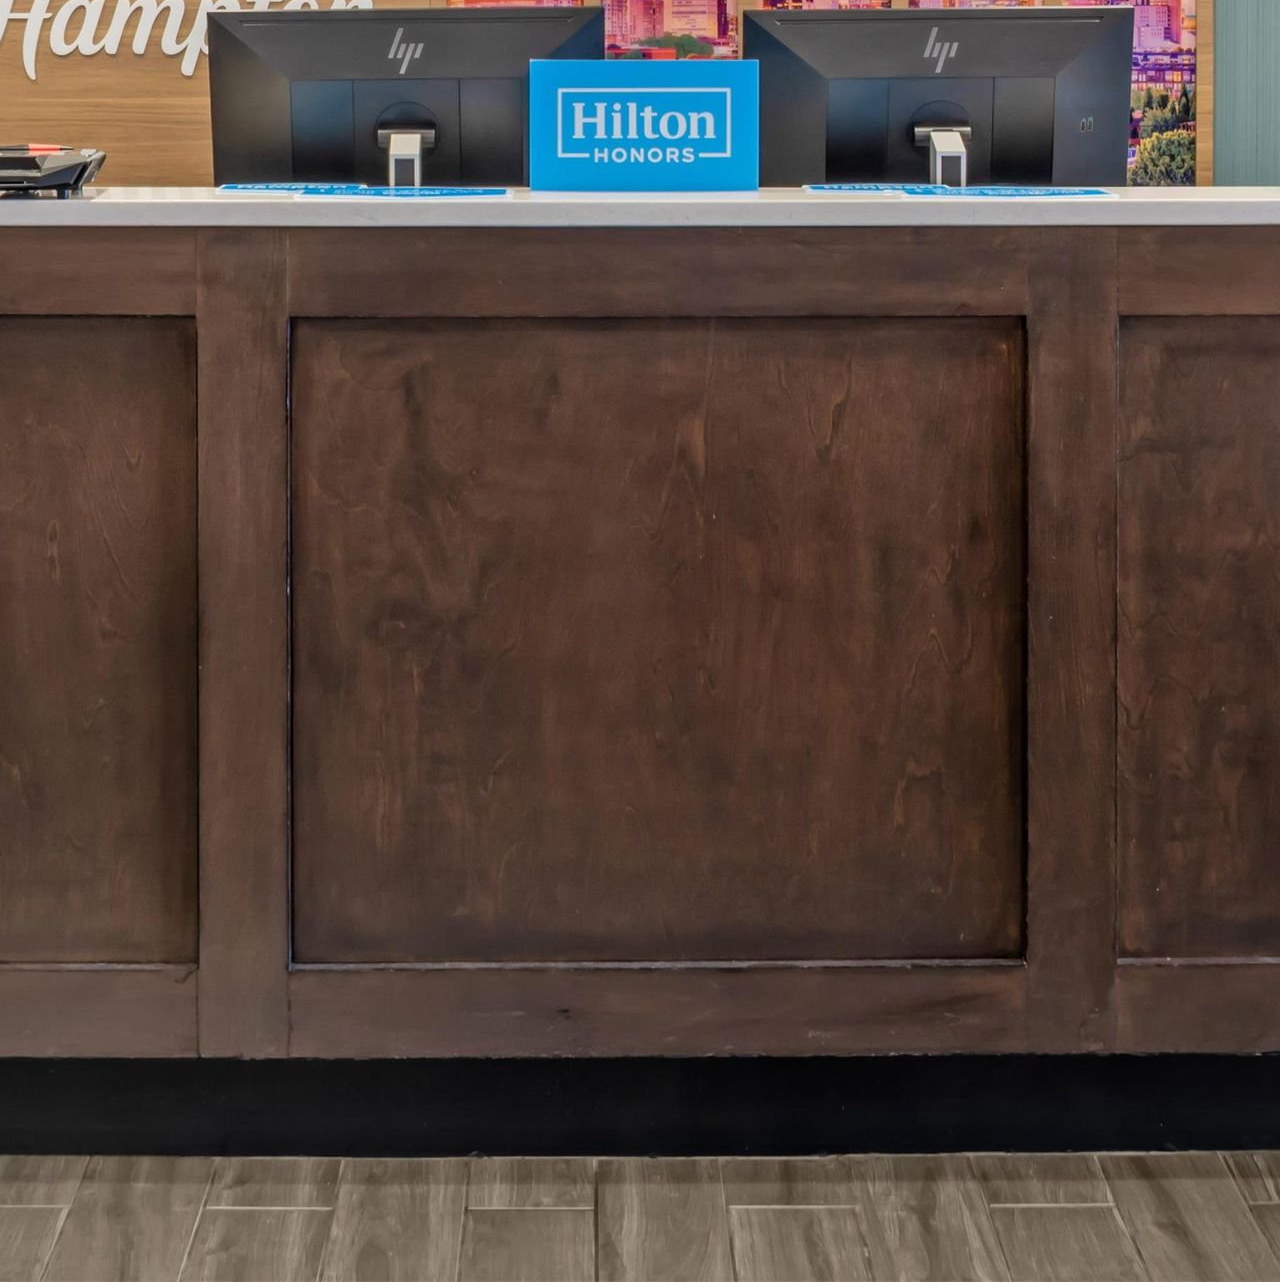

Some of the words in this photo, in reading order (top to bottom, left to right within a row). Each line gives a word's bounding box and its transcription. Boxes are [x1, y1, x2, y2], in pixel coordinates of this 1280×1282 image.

[387, 27, 425, 75] hp
[923, 26, 959, 74] hp
[572, 102, 716, 140] Hilton
[593, 147, 695, 164] HONORS
